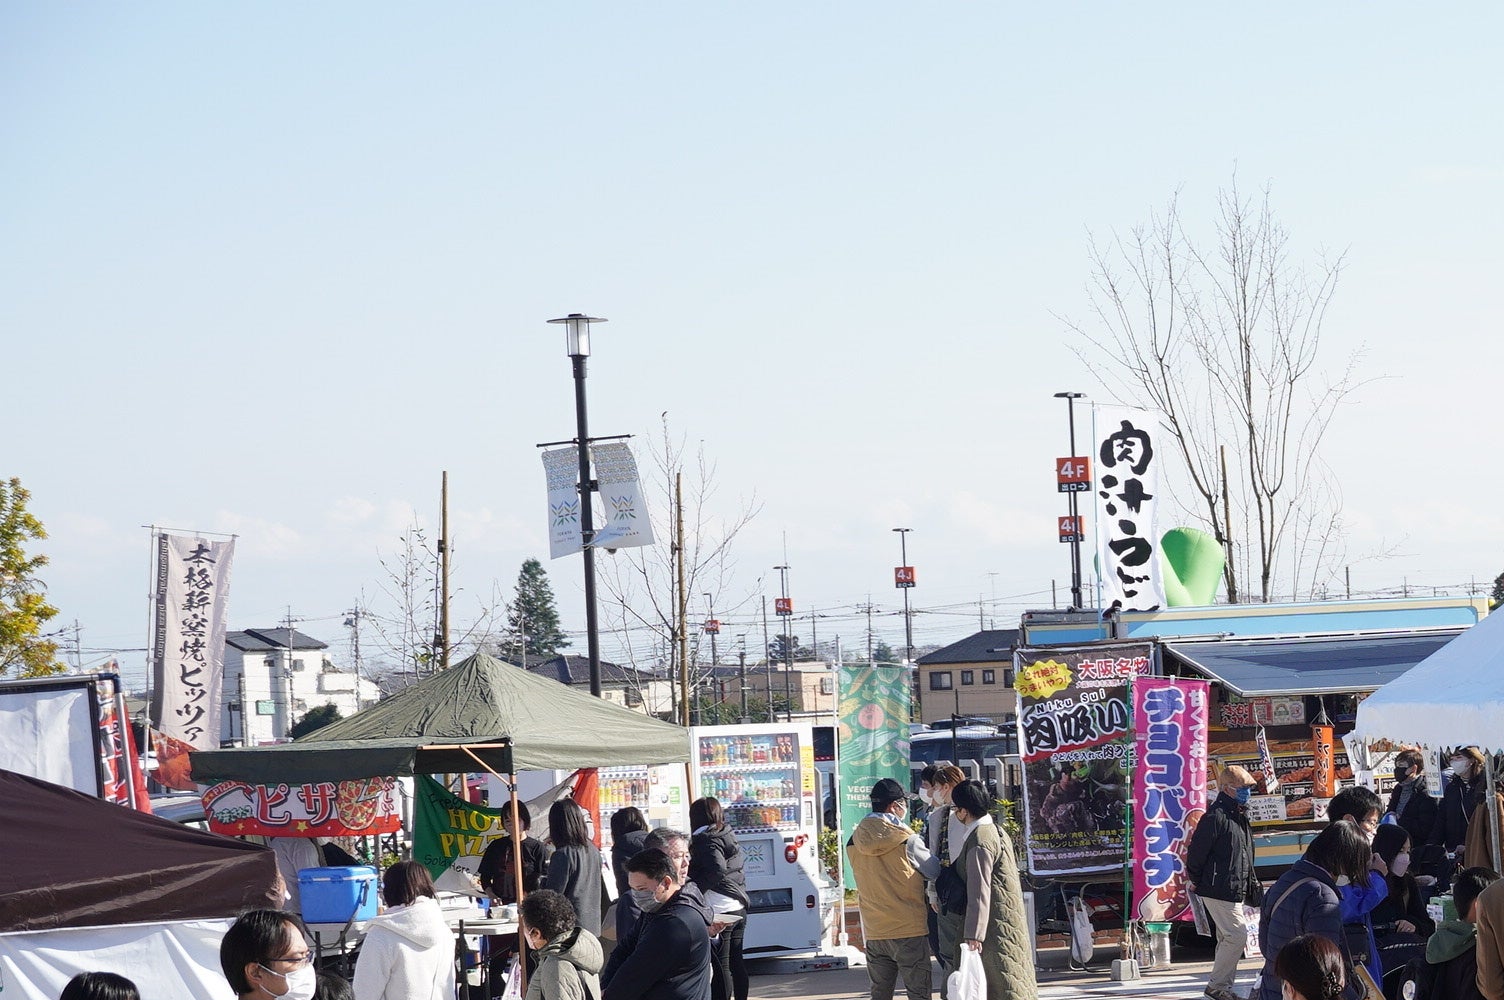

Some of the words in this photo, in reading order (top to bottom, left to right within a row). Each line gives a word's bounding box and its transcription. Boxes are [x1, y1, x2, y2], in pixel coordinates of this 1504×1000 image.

[1060, 461, 1085, 478] 4F
[1100, 419, 1160, 612] 肉汁うど
[896, 570, 912, 580] 4J
[776, 601, 790, 610] 4L
[1024, 664, 1060, 681] これ絶対
[1078, 657, 1150, 680] 大阪名物
[1020, 676, 1068, 694] うまいやつ!
[1035, 698, 1073, 715] Niku
[1080, 689, 1106, 703] Sui
[1021, 698, 1129, 755] 肉吸い
[1188, 688, 1206, 806] 甘くておいしい
[847, 785, 874, 793] VEGE
[1142, 685, 1187, 889] チョコバナナ
[255, 782, 336, 826] ピザ
